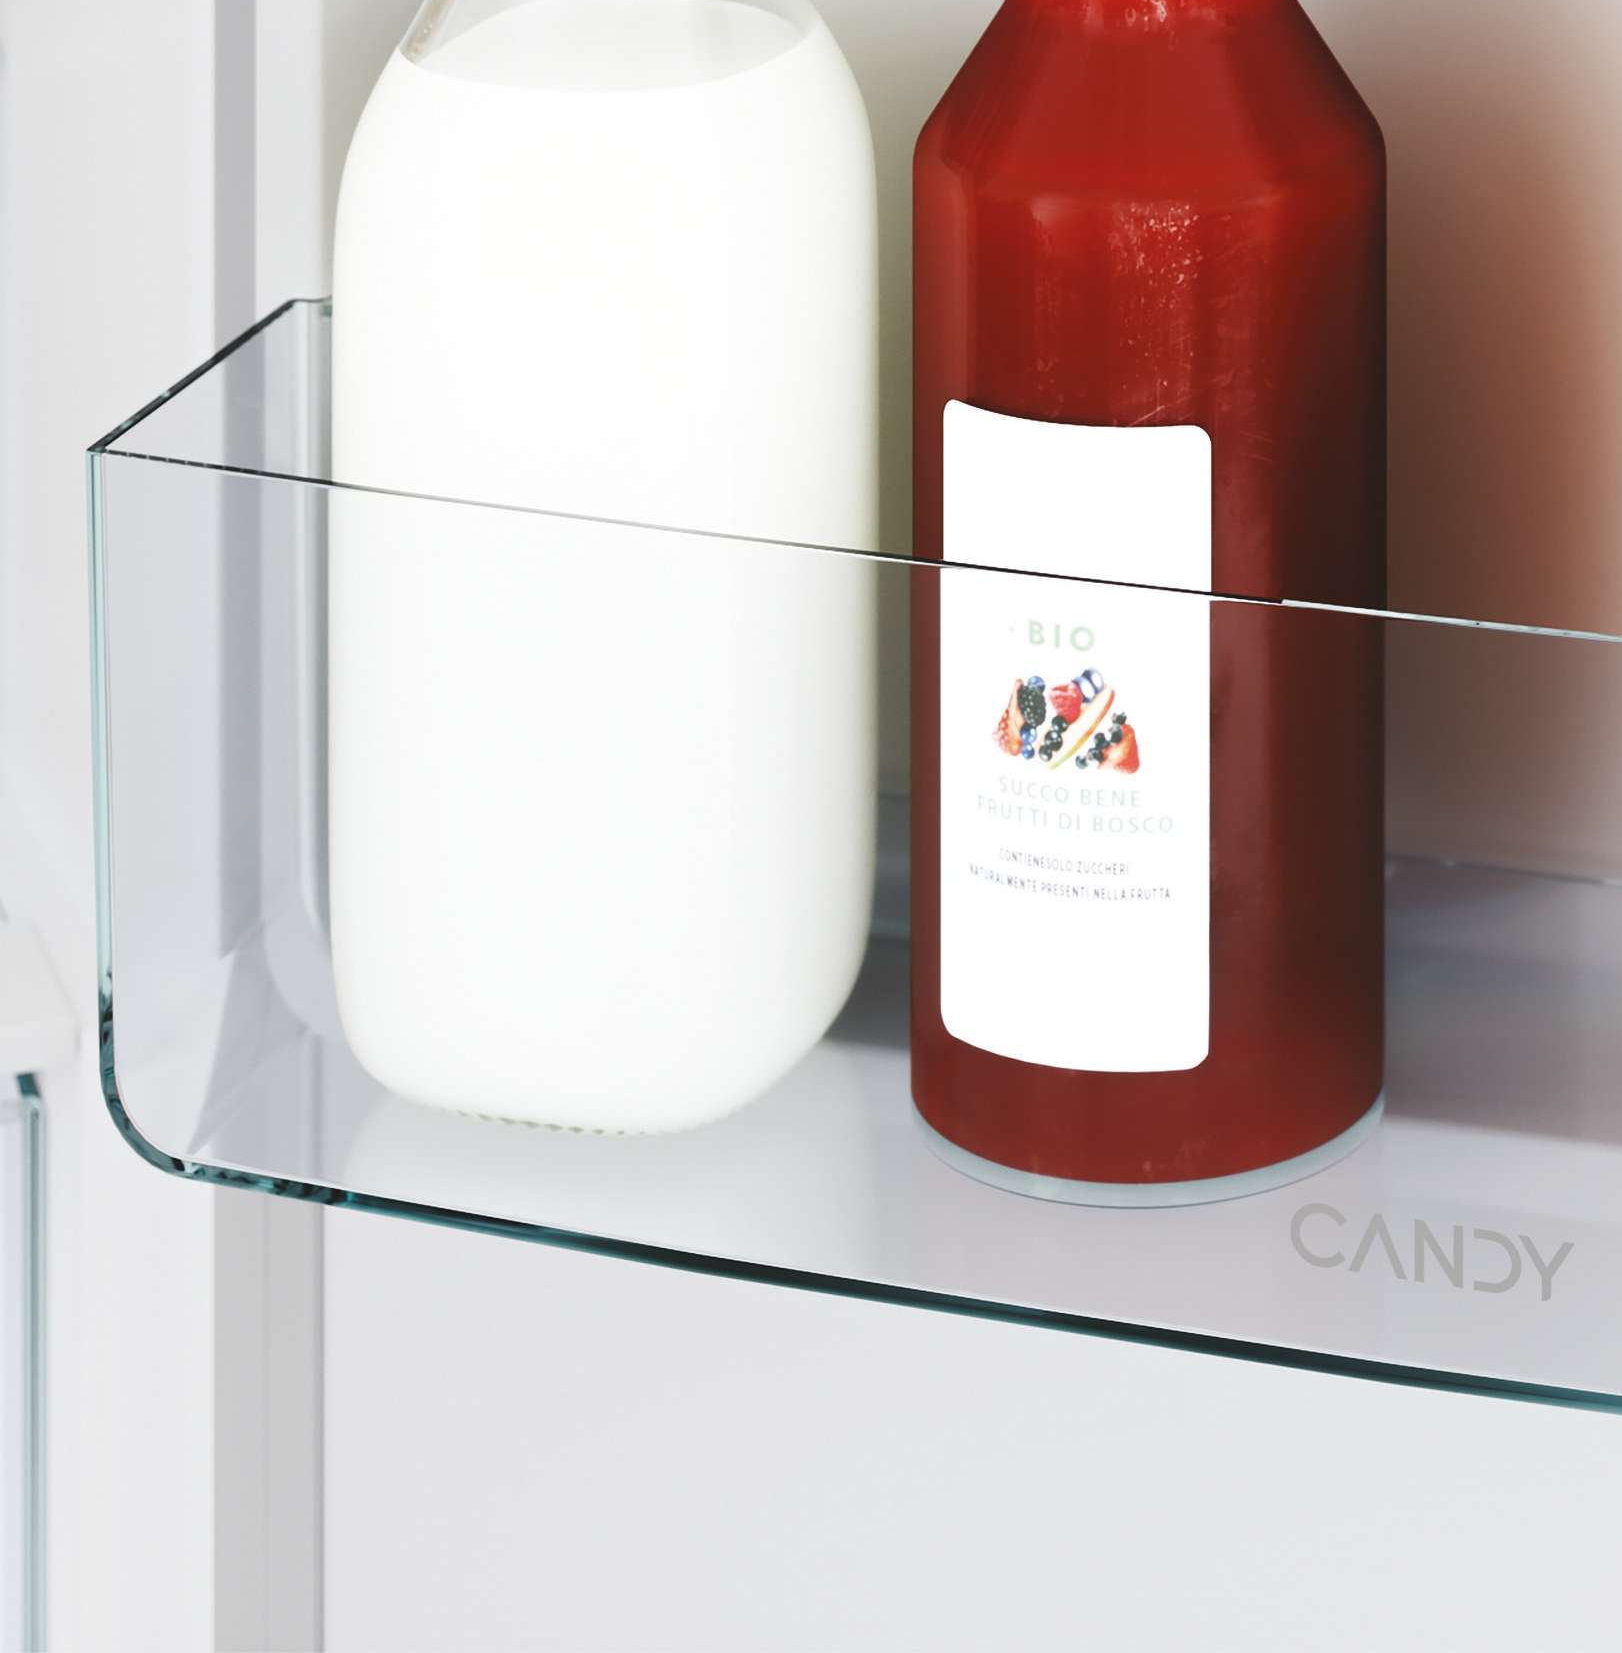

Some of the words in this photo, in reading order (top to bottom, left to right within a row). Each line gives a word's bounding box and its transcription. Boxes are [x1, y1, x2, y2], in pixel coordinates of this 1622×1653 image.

[1027, 619, 1096, 653] BIO
[998, 775, 1070, 804] SUCCO
[1079, 788, 1142, 809] BENE
[977, 794, 1048, 828] FRUTTI
[1058, 812, 1081, 832] DI
[1092, 815, 1174, 834] BOSCO
[1076, 860, 1130, 876] ZUCCHERI
[1093, 887, 1127, 901] NELLA
[1130, 887, 1172, 901] FRUTTA
[1290, 1202, 1576, 1302] CANDY
